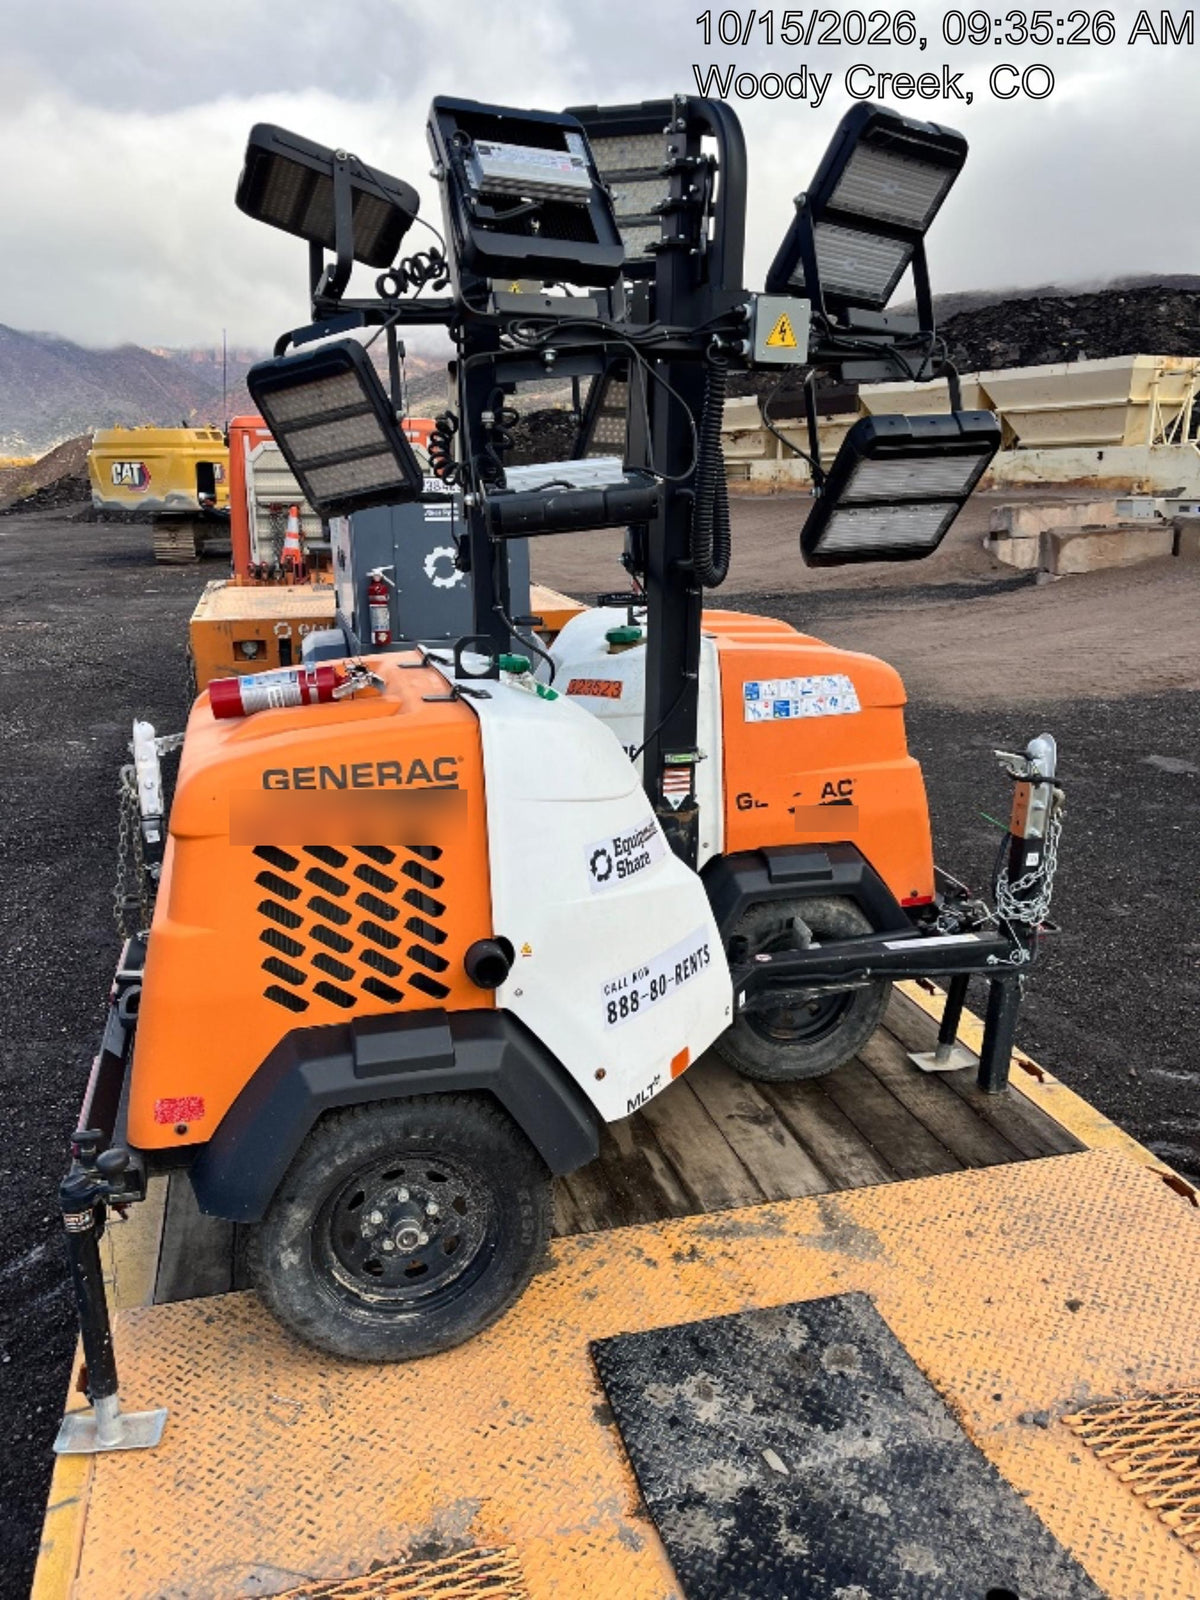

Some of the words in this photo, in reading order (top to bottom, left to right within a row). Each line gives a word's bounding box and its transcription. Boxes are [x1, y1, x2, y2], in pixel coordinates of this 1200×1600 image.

[111, 462, 141, 486] CAT
[262, 756, 459, 790] GENERAC
[616, 851, 651, 879] Share
[603, 977, 629, 996] CALL
[607, 943, 711, 1025] 888-80-RENTS
